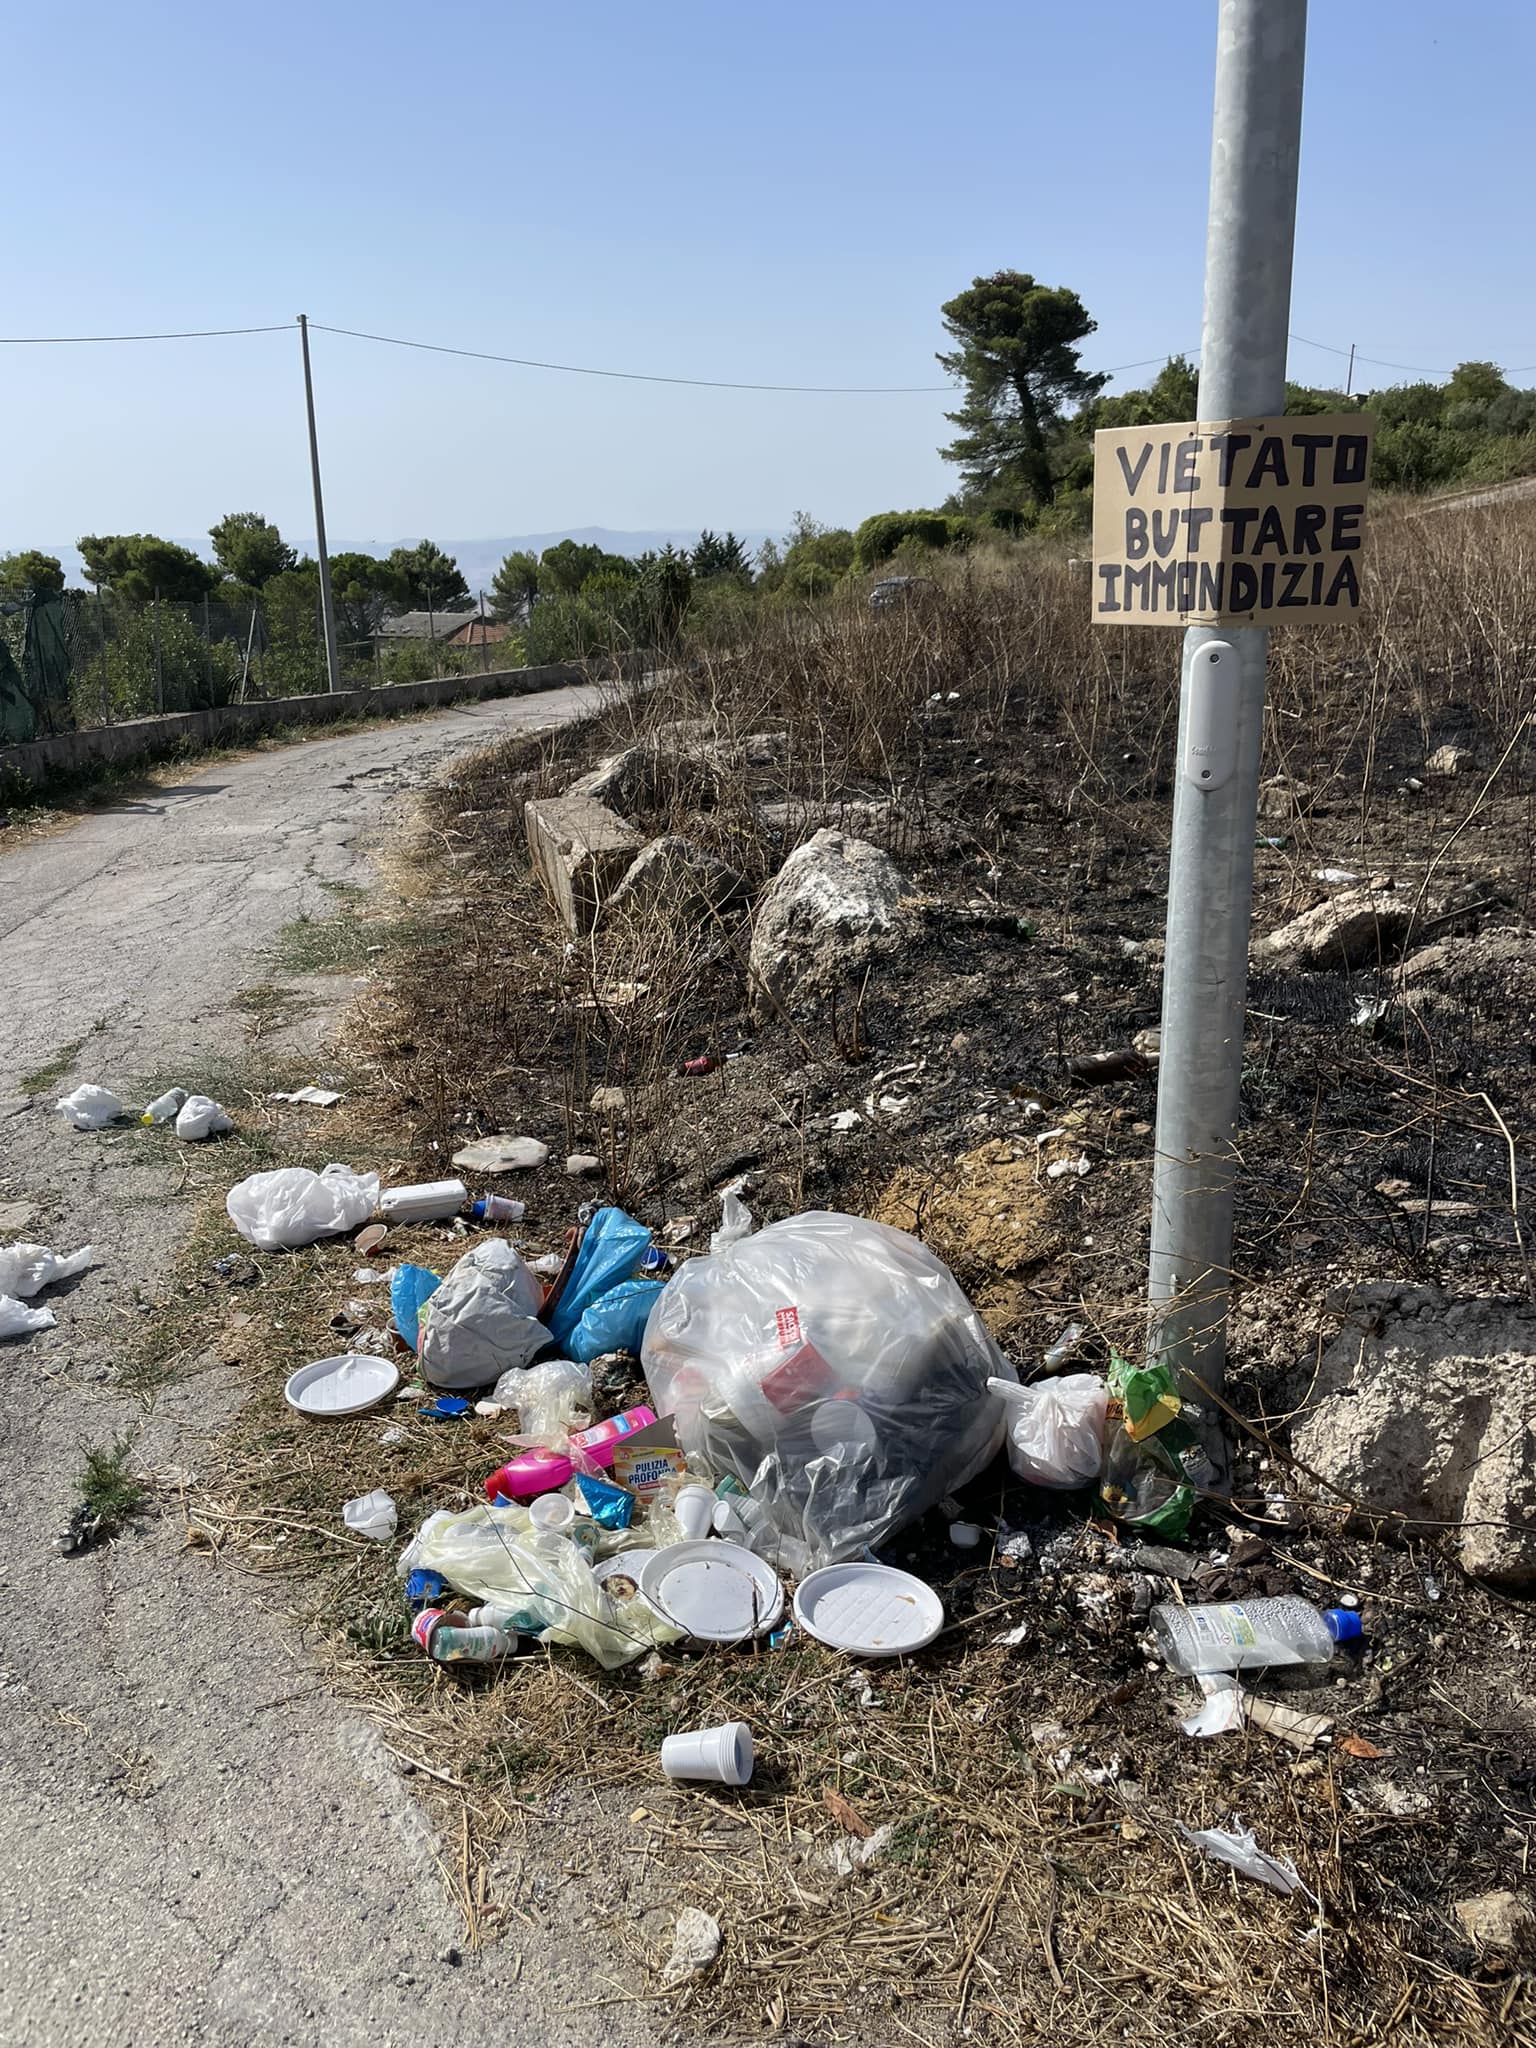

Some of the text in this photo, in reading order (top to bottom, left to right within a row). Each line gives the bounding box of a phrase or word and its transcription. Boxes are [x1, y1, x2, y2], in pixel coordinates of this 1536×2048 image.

[1116, 434, 1368, 496] VIETATO
[1125, 504, 1364, 560] BUTTARE
[1098, 555, 1360, 613] IMMONDIZIA
[635, 1459, 669, 1473] PULIZIA
